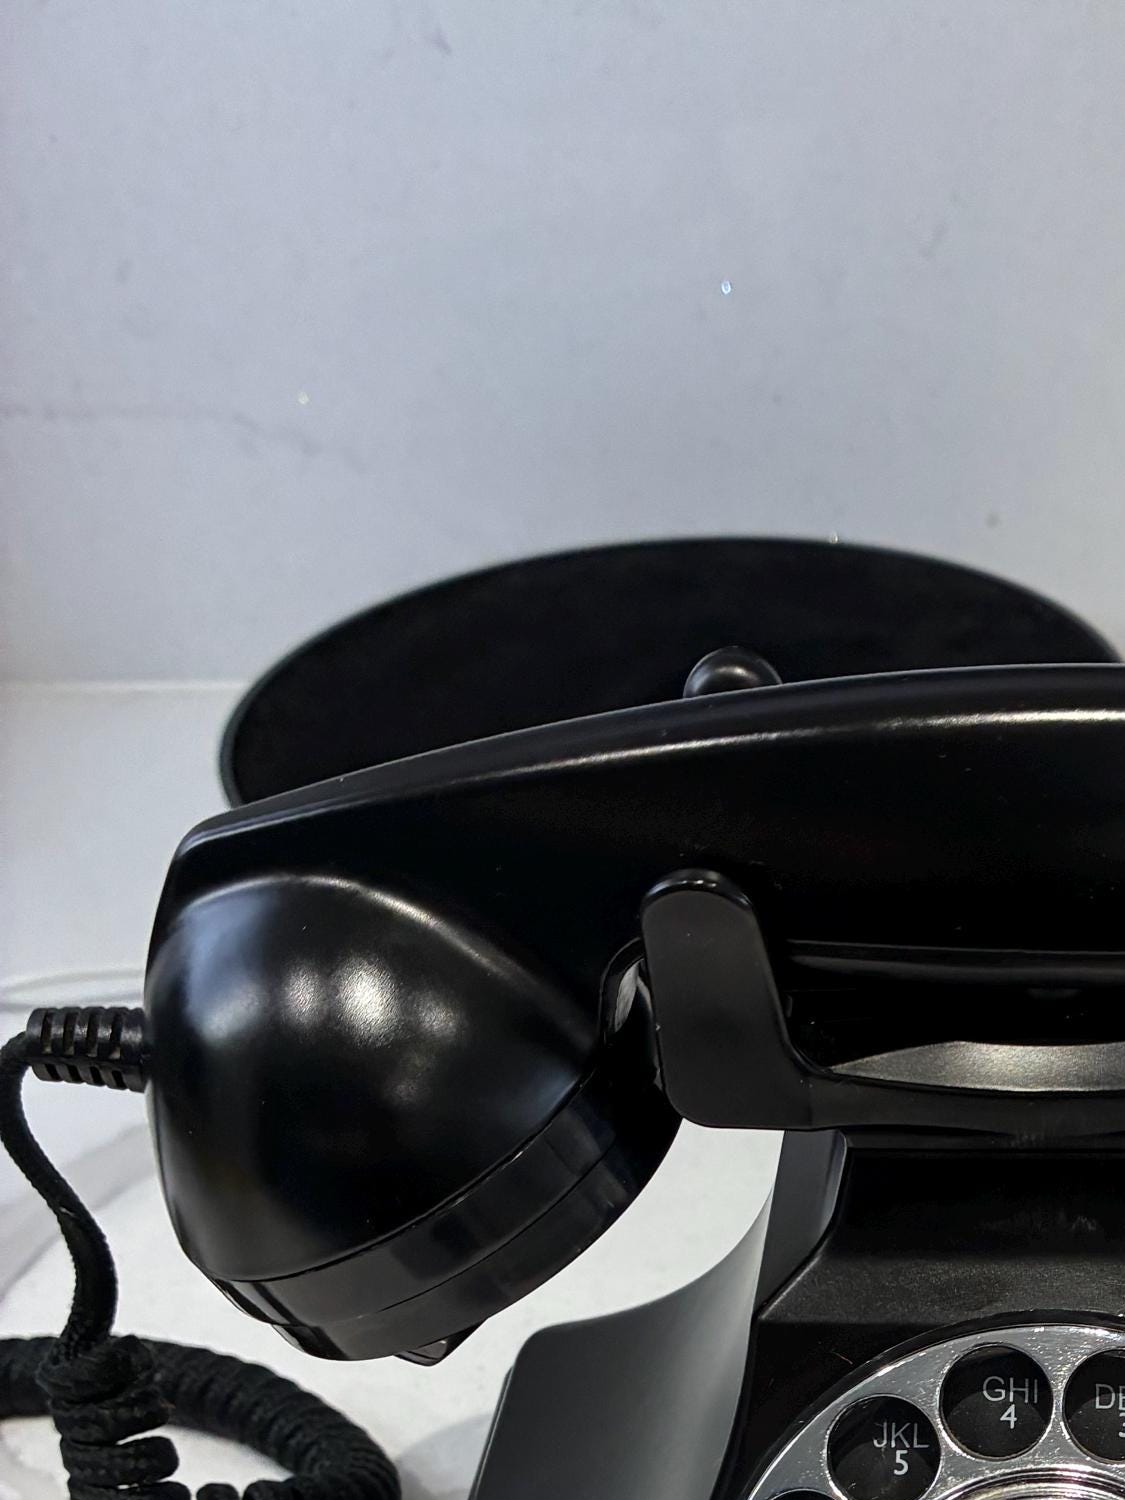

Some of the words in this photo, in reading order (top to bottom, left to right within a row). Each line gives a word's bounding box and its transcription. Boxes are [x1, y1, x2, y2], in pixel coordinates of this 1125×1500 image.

[983, 1376, 1038, 1404] GHI
[1000, 1404, 1017, 1429] 4
[873, 1422, 930, 1448] JKL
[893, 1449, 909, 1475] 5
